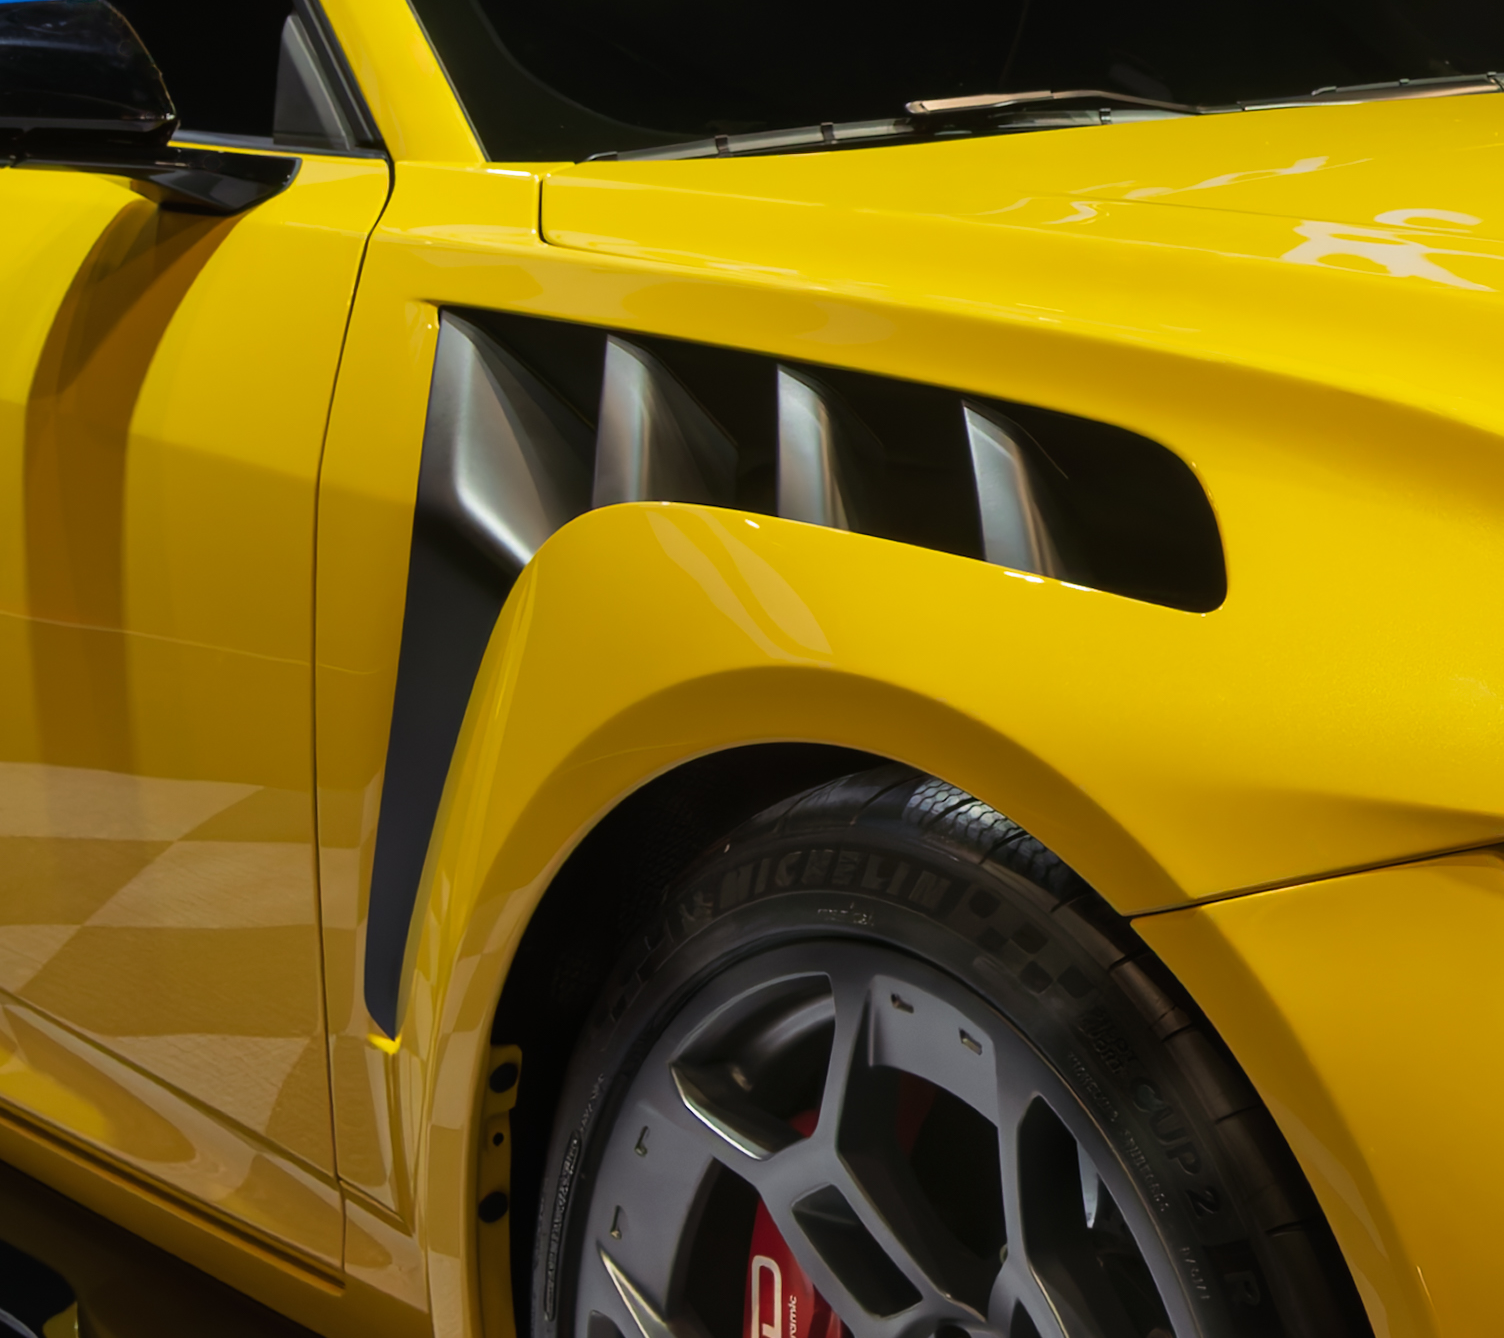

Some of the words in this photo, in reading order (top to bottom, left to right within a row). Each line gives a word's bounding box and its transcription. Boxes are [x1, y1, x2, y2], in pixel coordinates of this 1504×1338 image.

[719, 848, 952, 912] MICHELIN
[1132, 1082, 1203, 1175] CUP
[1188, 1185, 1220, 1218] 2
